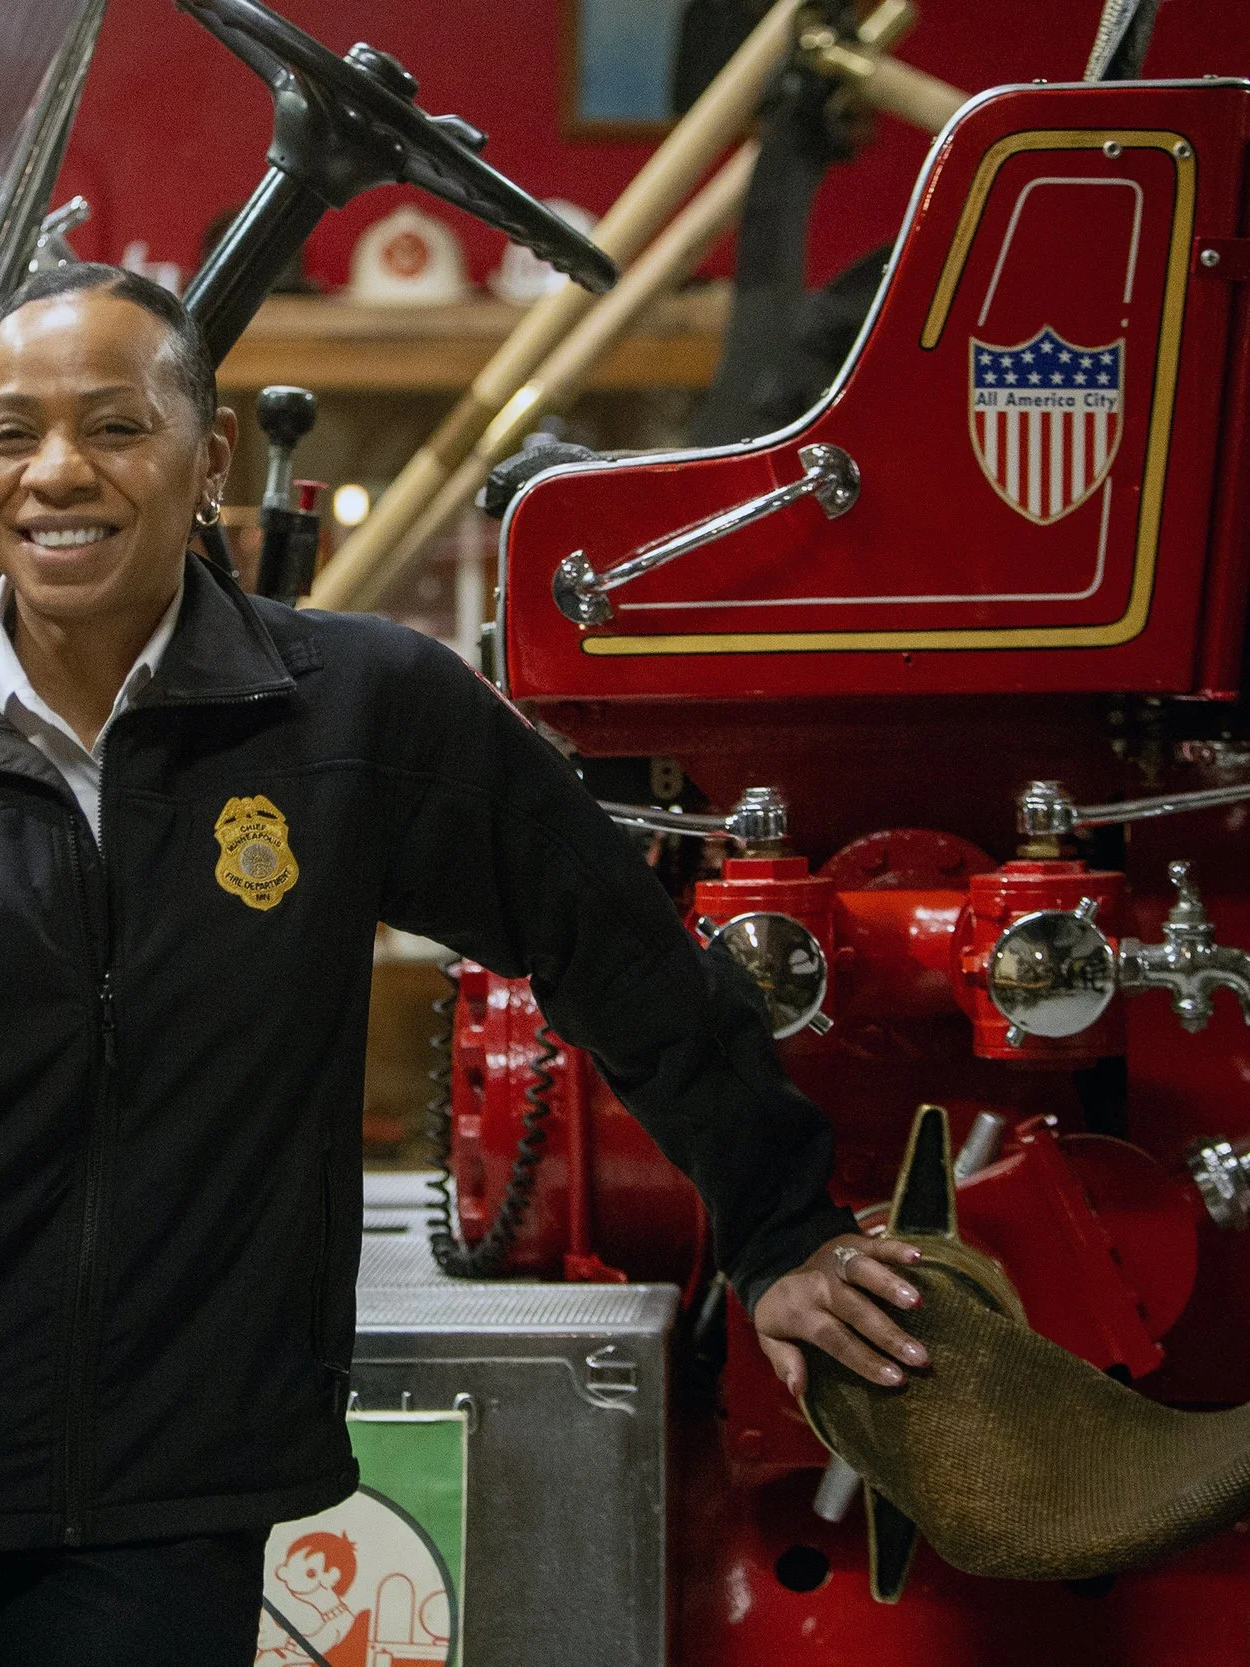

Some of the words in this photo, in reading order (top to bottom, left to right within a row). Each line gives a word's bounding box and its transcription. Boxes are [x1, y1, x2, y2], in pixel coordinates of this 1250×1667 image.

[975, 391, 998, 406] All
[1005, 391, 1076, 407] America
[1083, 392, 1117, 411] City
[240, 823, 267, 833] CHIEF
[227, 832, 281, 852] MINNEAPOLIS
[225, 872, 242, 887] FIRE
[244, 868, 291, 890] DEPARTMENT
[255, 893, 270, 901] MN
